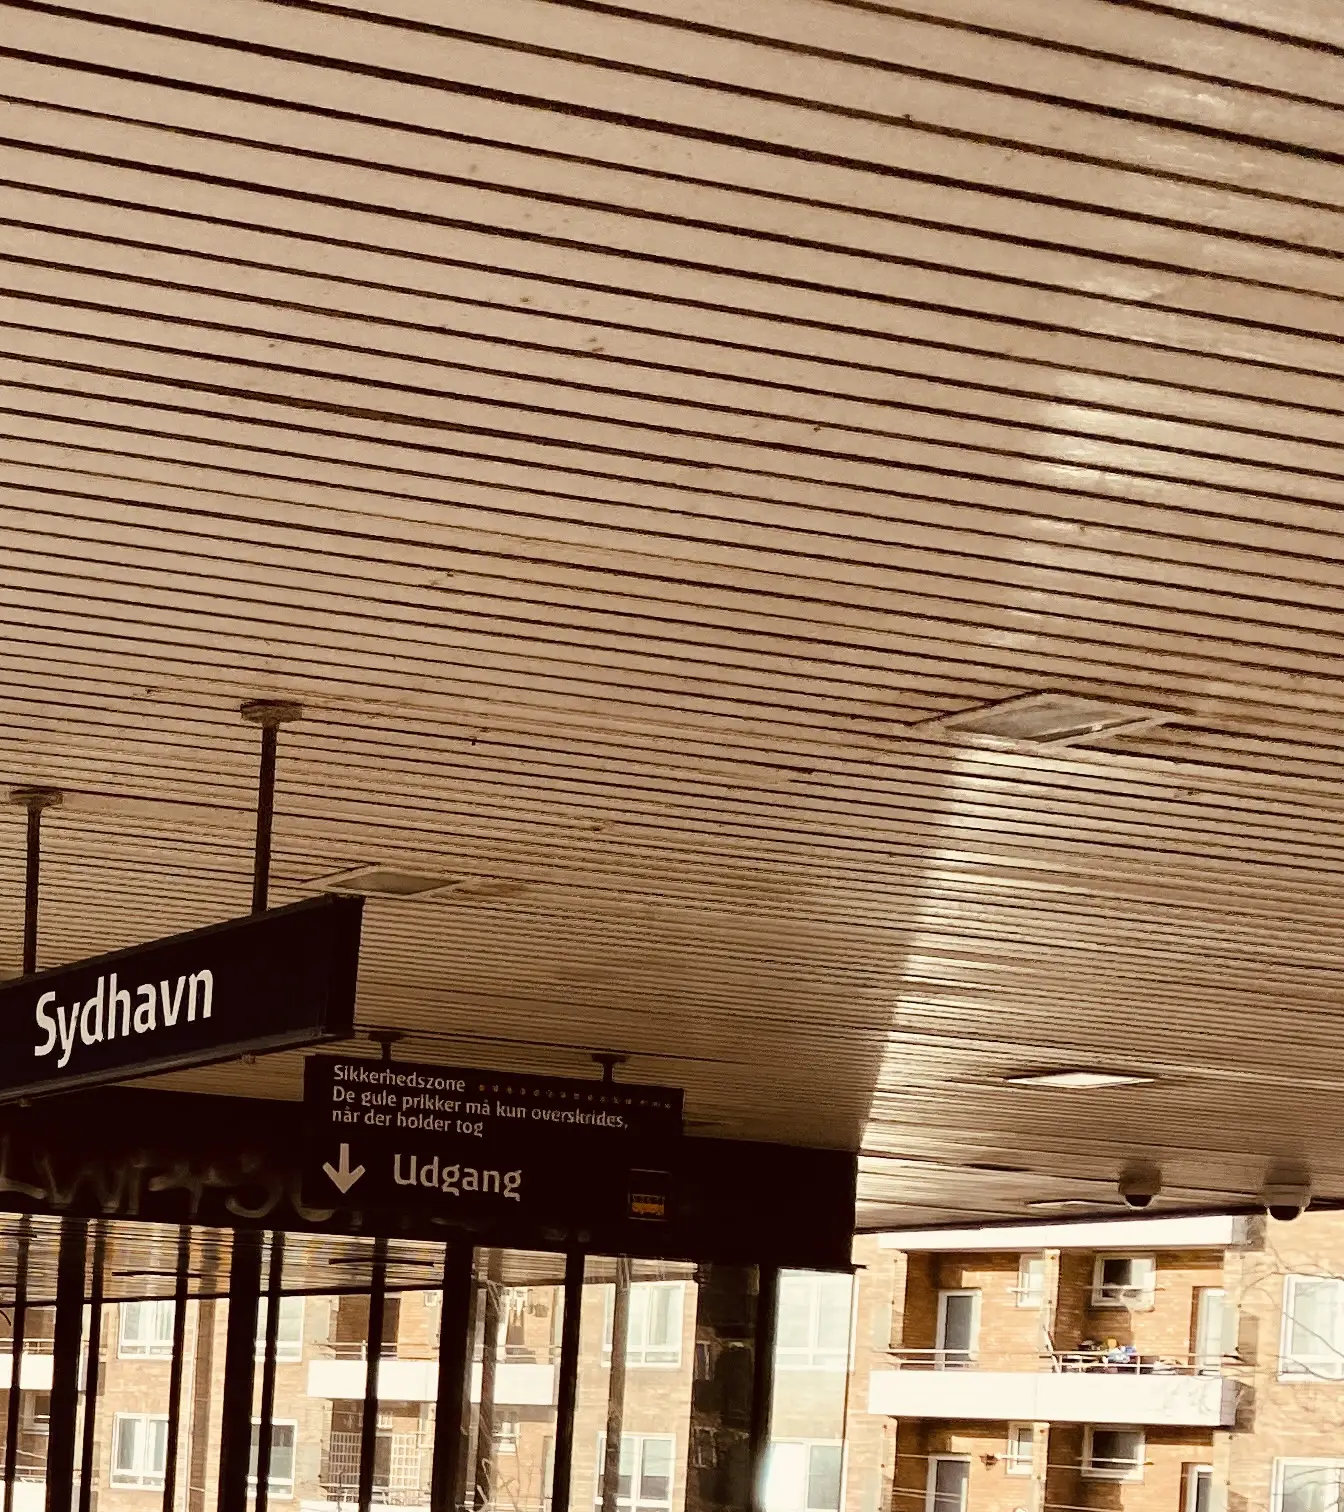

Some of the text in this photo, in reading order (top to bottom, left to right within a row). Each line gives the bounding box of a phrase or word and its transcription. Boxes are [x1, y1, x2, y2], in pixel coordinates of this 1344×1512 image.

[34, 968, 214, 1069] Sydhavn
[332, 1064, 466, 1092] Sikkerhedszone
[332, 1085, 629, 1131] De gule prikker må kun overskrides,
[332, 1106, 483, 1138] når der holder tog
[393, 1153, 523, 1202] Udgang
